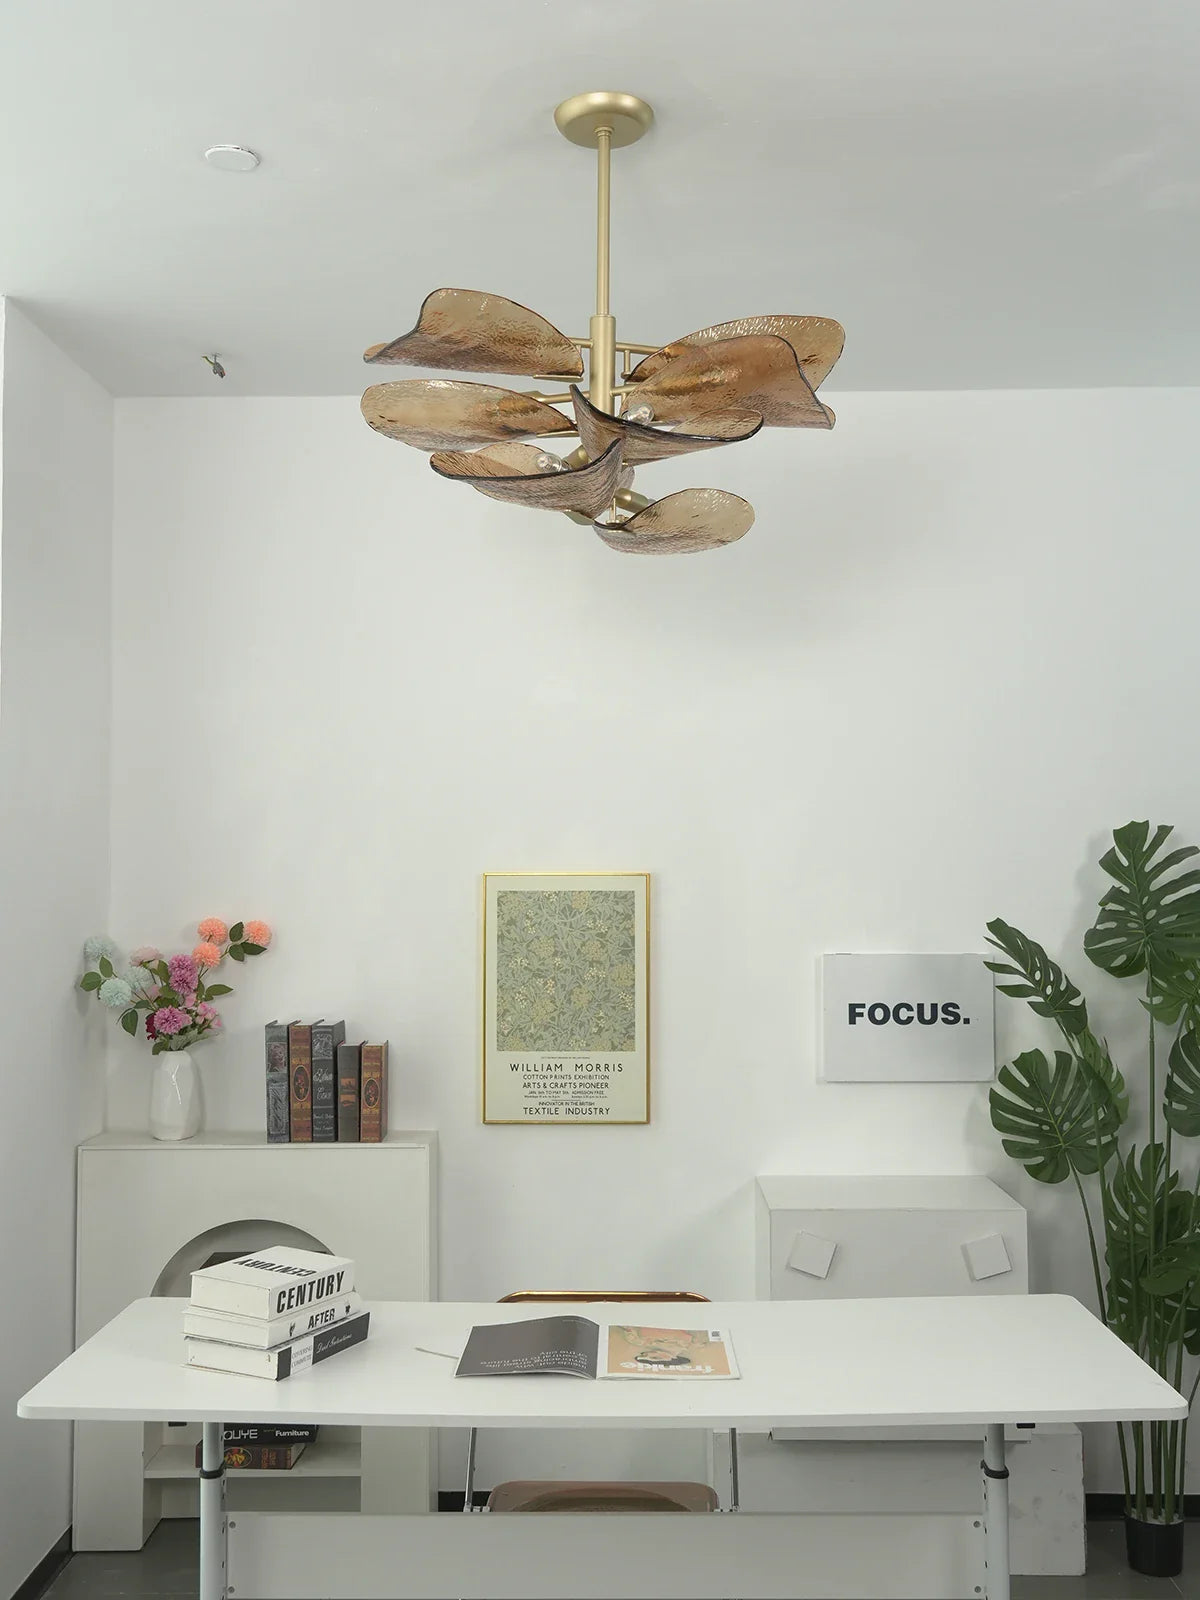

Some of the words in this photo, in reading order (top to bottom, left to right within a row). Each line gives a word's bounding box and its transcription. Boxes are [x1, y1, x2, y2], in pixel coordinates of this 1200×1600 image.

[848, 1002, 970, 1026] FOCUS.
[509, 1063, 563, 1072] WILLIAM
[574, 1063, 624, 1072] MORRIS
[522, 1107, 559, 1115] TEXTILE
[565, 1107, 611, 1115] INDUSTRY
[233, 1258, 317, 1275] CENTURY
[276, 1270, 345, 1314] CENTURY
[307, 1308, 336, 1330] AFTER
